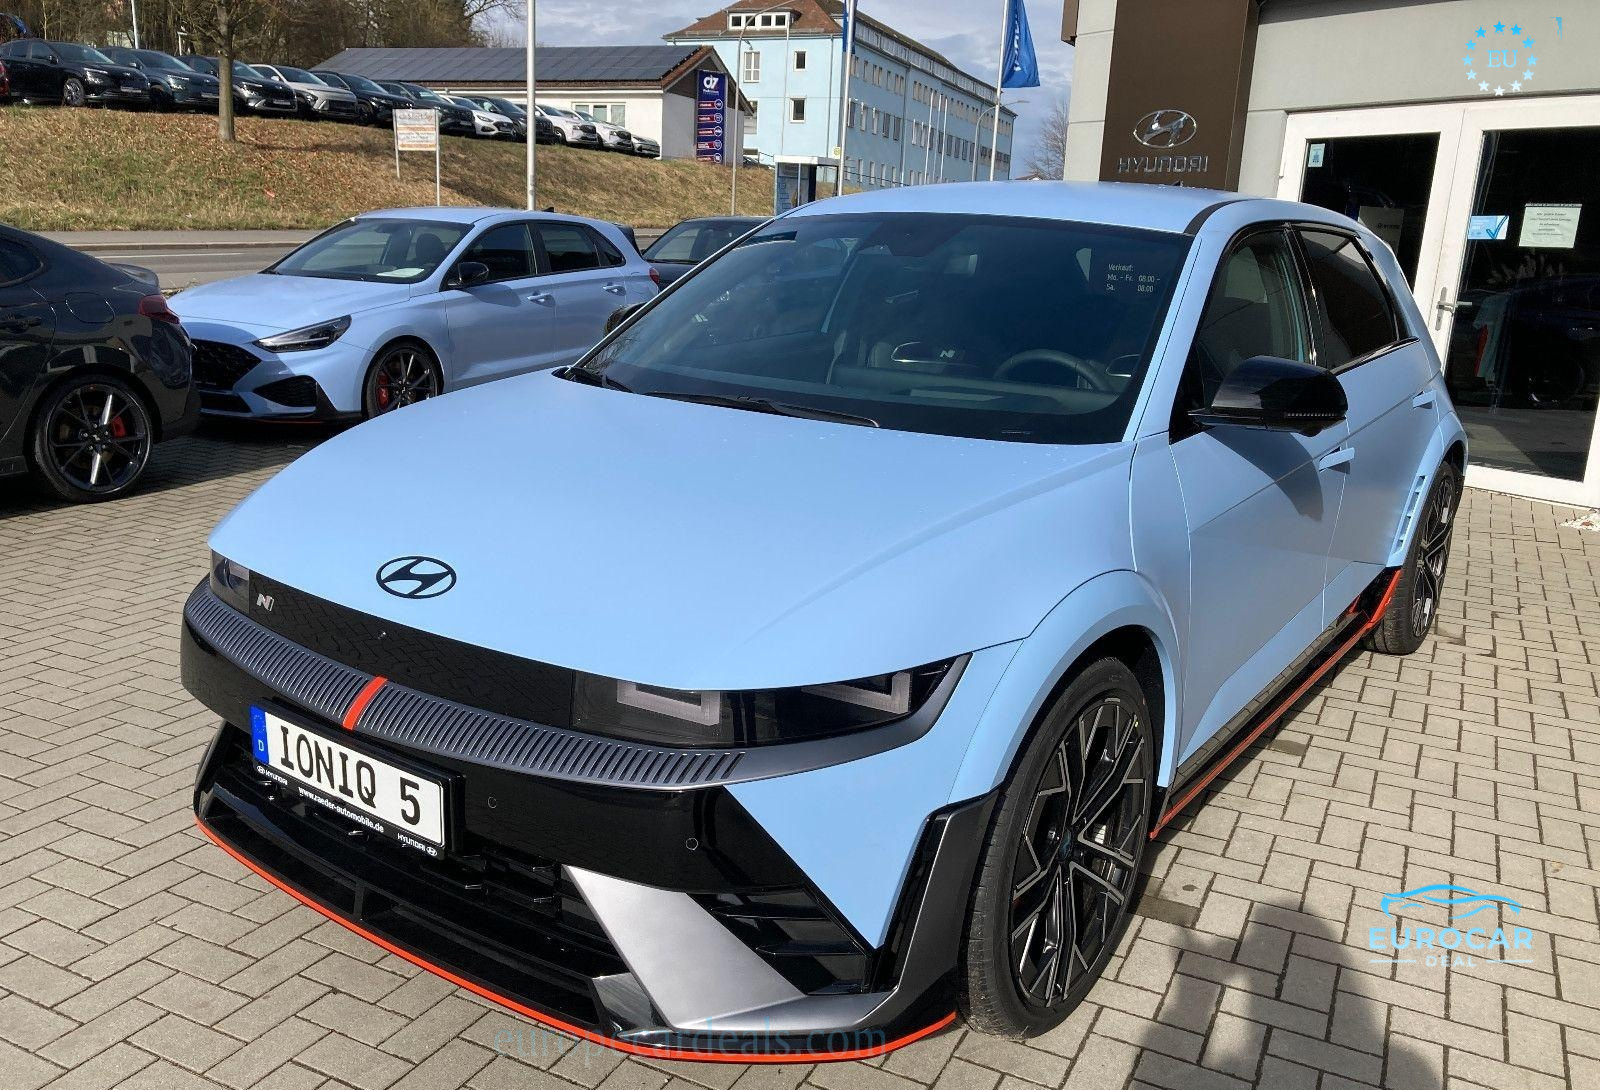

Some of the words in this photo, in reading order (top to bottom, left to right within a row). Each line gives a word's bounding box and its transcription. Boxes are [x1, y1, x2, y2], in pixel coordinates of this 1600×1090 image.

[1118, 155, 1209, 173] HYUNDAI
[1108, 263, 1134, 272] Verkauf:
[256, 593, 275, 612] N
[258, 739, 265, 752] D
[265, 769, 288, 786] HYUNDAI
[280, 725, 377, 809] IONIQ
[399, 776, 421, 826] 5
[298, 786, 385, 833] www.raeder-automobile.de
[397, 832, 426, 852] HYUNDAI
